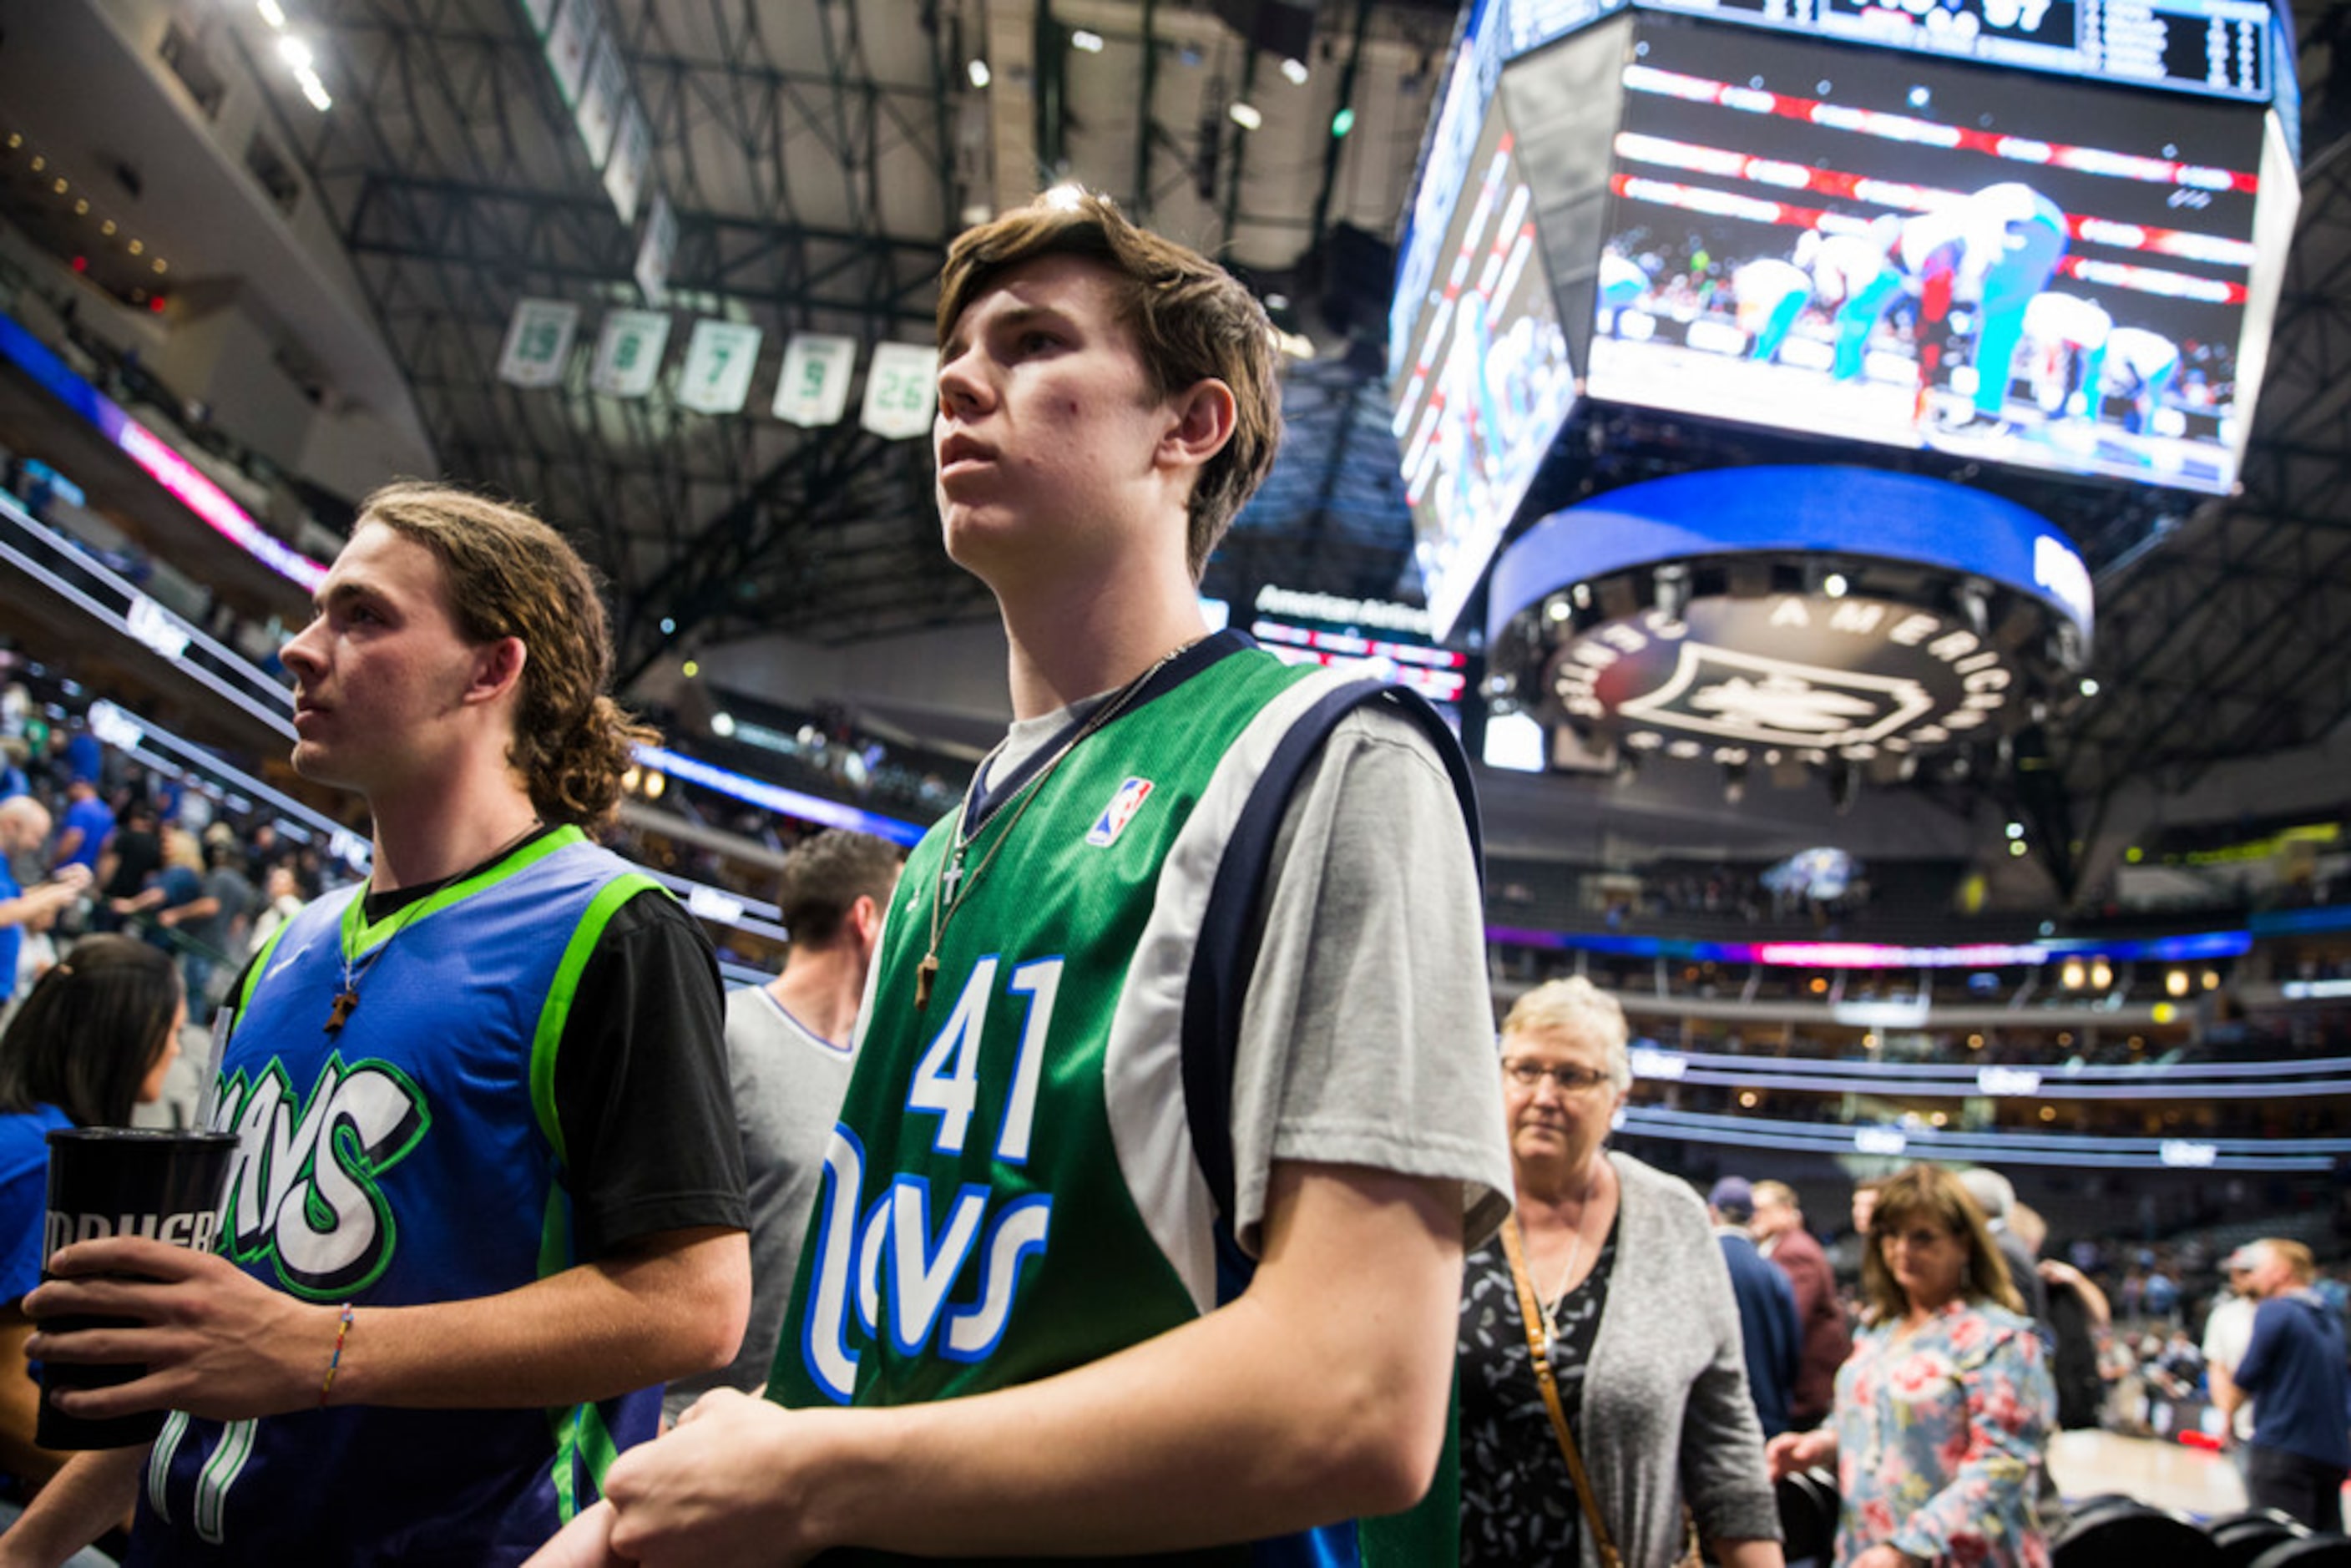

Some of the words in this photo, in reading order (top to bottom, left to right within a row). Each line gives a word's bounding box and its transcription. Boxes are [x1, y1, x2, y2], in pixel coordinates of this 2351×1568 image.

[707, 347, 732, 385] 7
[800, 359, 827, 397] 9
[877, 367, 926, 409] 26
[905, 952, 1065, 1166] 41
[212, 1049, 432, 1300] AVS
